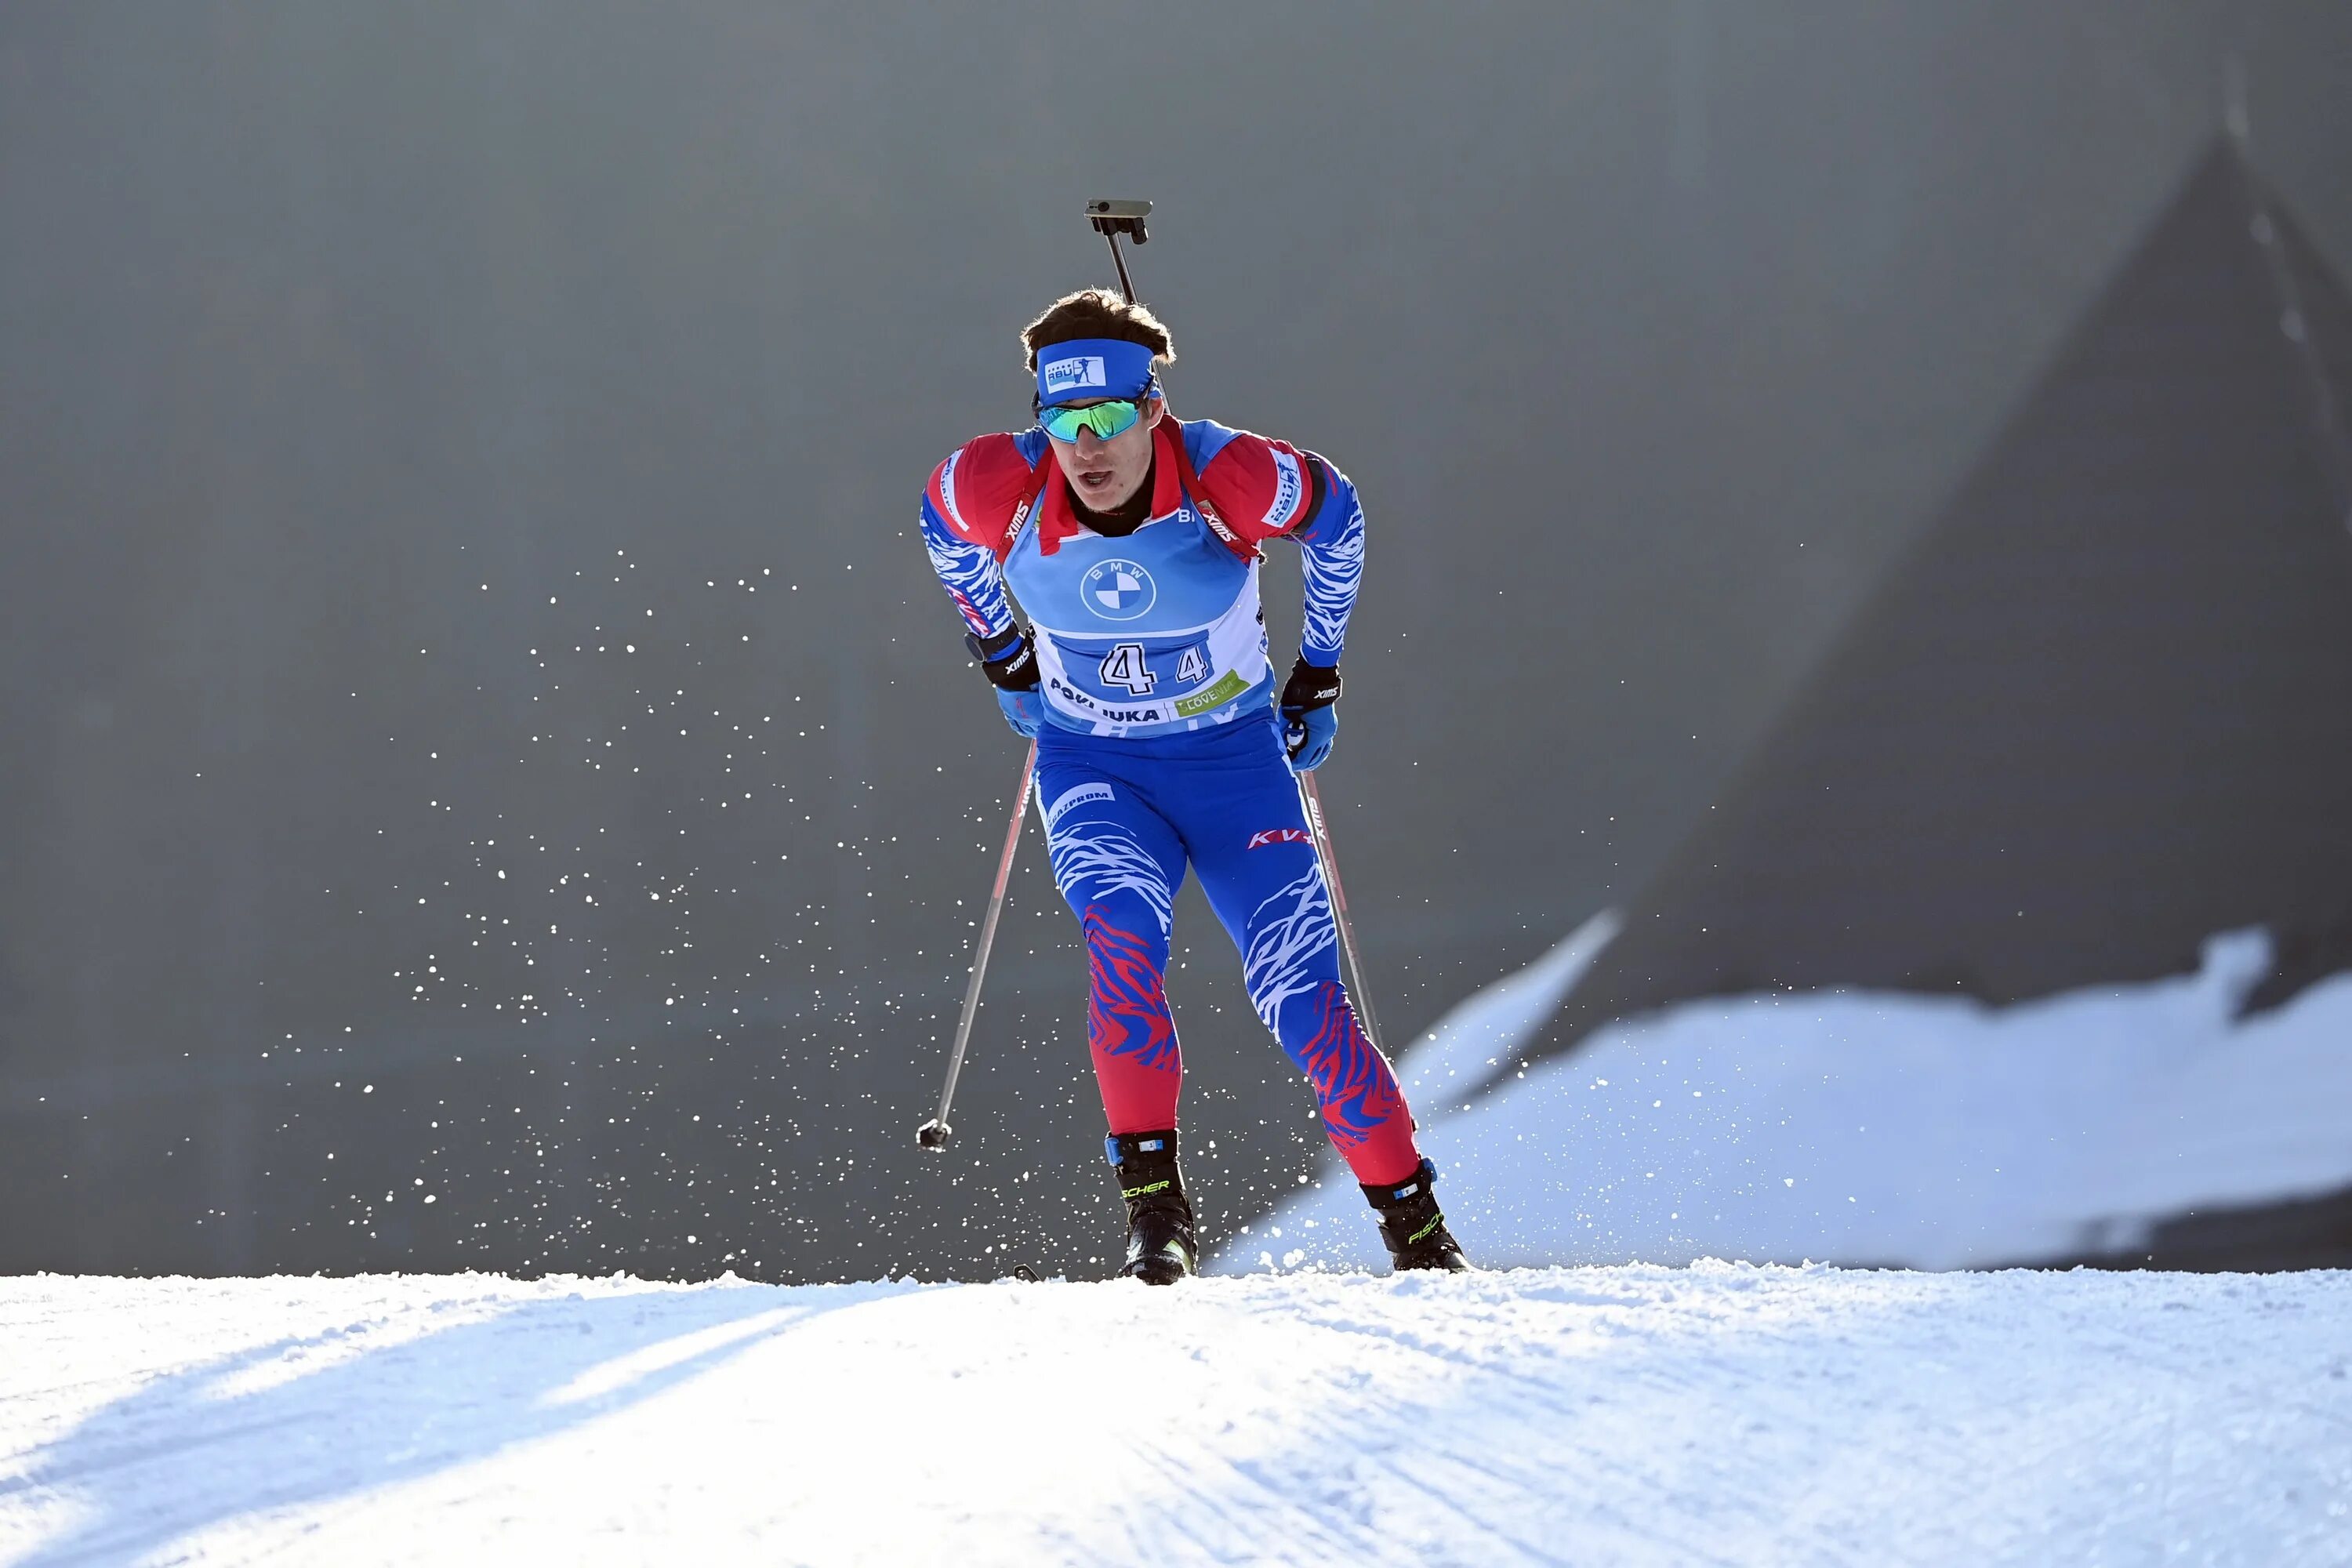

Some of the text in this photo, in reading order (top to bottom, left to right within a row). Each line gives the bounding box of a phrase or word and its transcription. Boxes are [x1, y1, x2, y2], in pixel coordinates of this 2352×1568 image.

[1047, 366, 1073, 381] RBU
[1273, 485, 1295, 522] RBU
[1005, 499, 1029, 541] SWIX
[1202, 511, 1239, 543] SWIX
[1090, 562, 1144, 580] BMW
[1005, 646, 1030, 674] SWIX
[1098, 643, 1208, 696] 4 4
[1313, 686, 1338, 699] SWIX
[1052, 792, 1109, 824] GAZPROM
